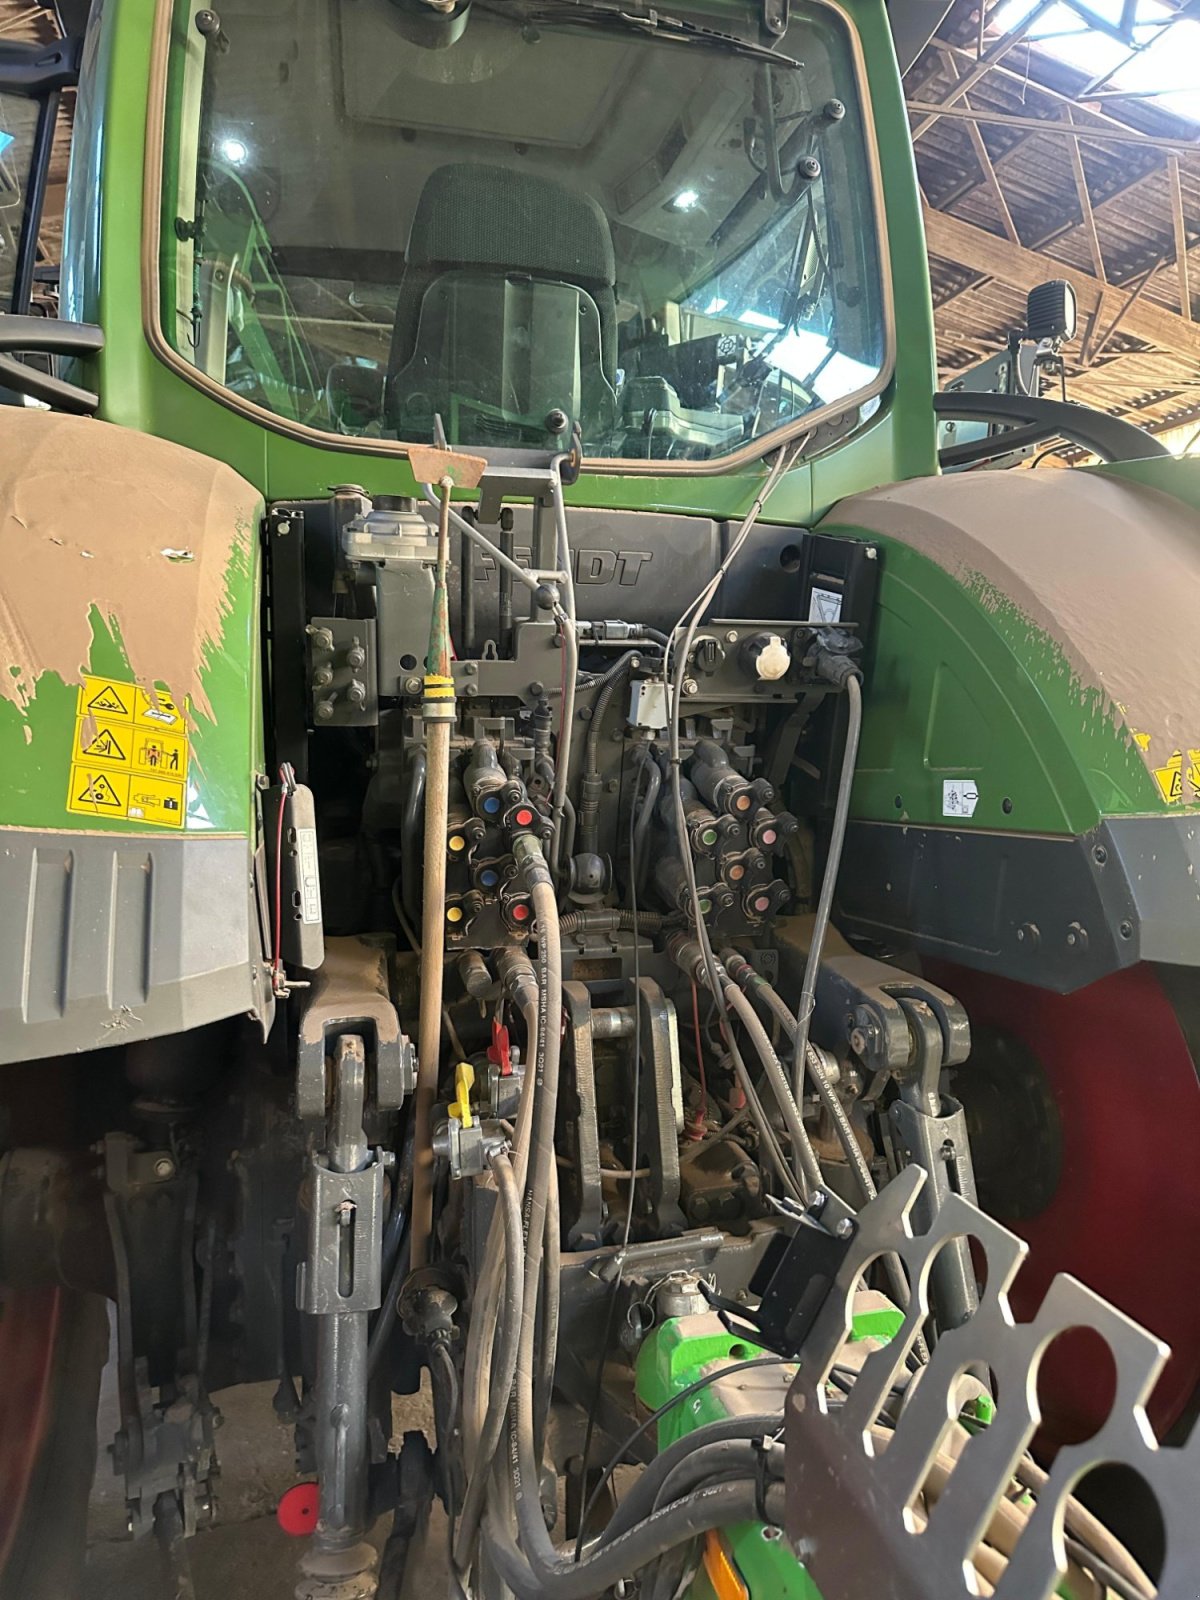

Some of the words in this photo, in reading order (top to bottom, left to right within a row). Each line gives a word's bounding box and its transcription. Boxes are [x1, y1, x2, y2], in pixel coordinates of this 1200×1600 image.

[471, 544, 653, 586] FEDT
[807, 1051, 818, 1064] 853
[814, 1064, 826, 1080] 2SN
[822, 1080, 830, 1089] 10
[827, 1089, 837, 1102] WP
[833, 1103, 843, 1117] 330
[840, 1117, 851, 1135] BAR
[522, 1189, 534, 1242] HANSA-FLEX
